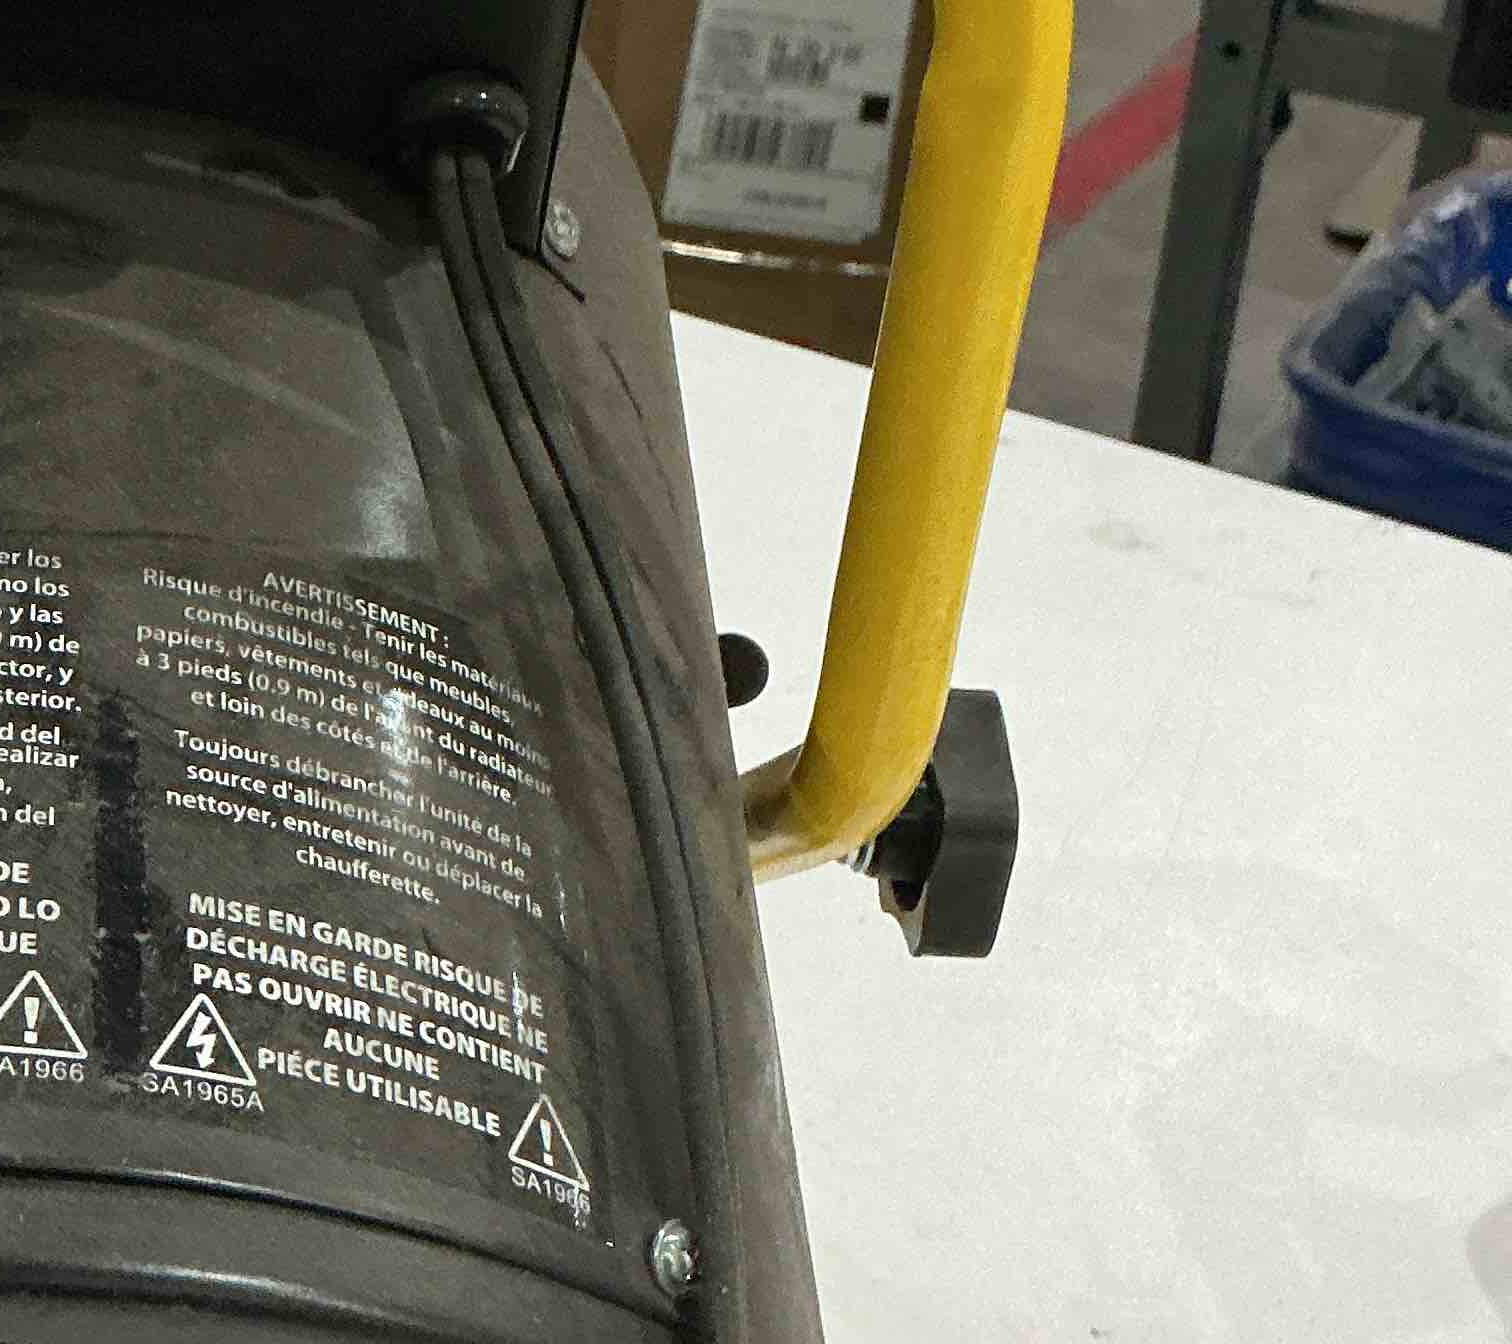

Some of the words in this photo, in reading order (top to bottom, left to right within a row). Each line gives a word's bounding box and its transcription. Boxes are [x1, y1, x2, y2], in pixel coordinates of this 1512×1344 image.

[28, 550, 62, 569] los
[34, 578, 70, 598] los
[30, 605, 63, 624] las
[143, 568, 222, 600] Risque
[361, 622, 414, 654] Tenir
[420, 641, 448, 666] les
[264, 572, 439, 642] AVERTISSEMENT
[48, 634, 80, 654] de
[184, 603, 337, 656] combustibles
[386, 660, 424, 687] que
[177, 658, 242, 687] pieds
[331, 692, 357, 715] de
[439, 731, 466, 757] du
[191, 688, 215, 707] et
[220, 692, 264, 720] loin
[271, 707, 310, 730] des
[238, 642, 356, 688] vêtements
[469, 719, 492, 741] au
[20, 724, 61, 745] del
[14, 804, 55, 825] del
[173, 728, 280, 772] Toujours
[420, 796, 482, 835] l'unité
[488, 822, 511, 847] de
[517, 835, 532, 858] la
[186, 760, 266, 796] source
[440, 834, 495, 869] avant
[500, 855, 525, 881] de
[165, 787, 277, 829] nettoyer,
[283, 816, 396, 859] entretenir
[403, 847, 429, 869] ou
[526, 895, 543, 918] la
[295, 846, 440, 905] chaufferette.
[19, 897, 61, 921] LO
[188, 893, 262, 926] MISE
[268, 909, 306, 937] EN
[312, 922, 408, 966] GARDE
[414, 951, 506, 1001] RISQUE
[186, 926, 346, 982] DÉCHARGE
[353, 960, 510, 1036] ÉLECTRIQUE
[193, 962, 251, 995] PAS
[258, 978, 371, 1024] OUVRIR
[377, 1007, 413, 1036] NE
[419, 1021, 546, 1084] CONTIENT
[323, 1028, 440, 1081] AUCUNE
[141, 1073, 264, 1112] SA1965A
[346, 1071, 502, 1137] UTILISABLE
